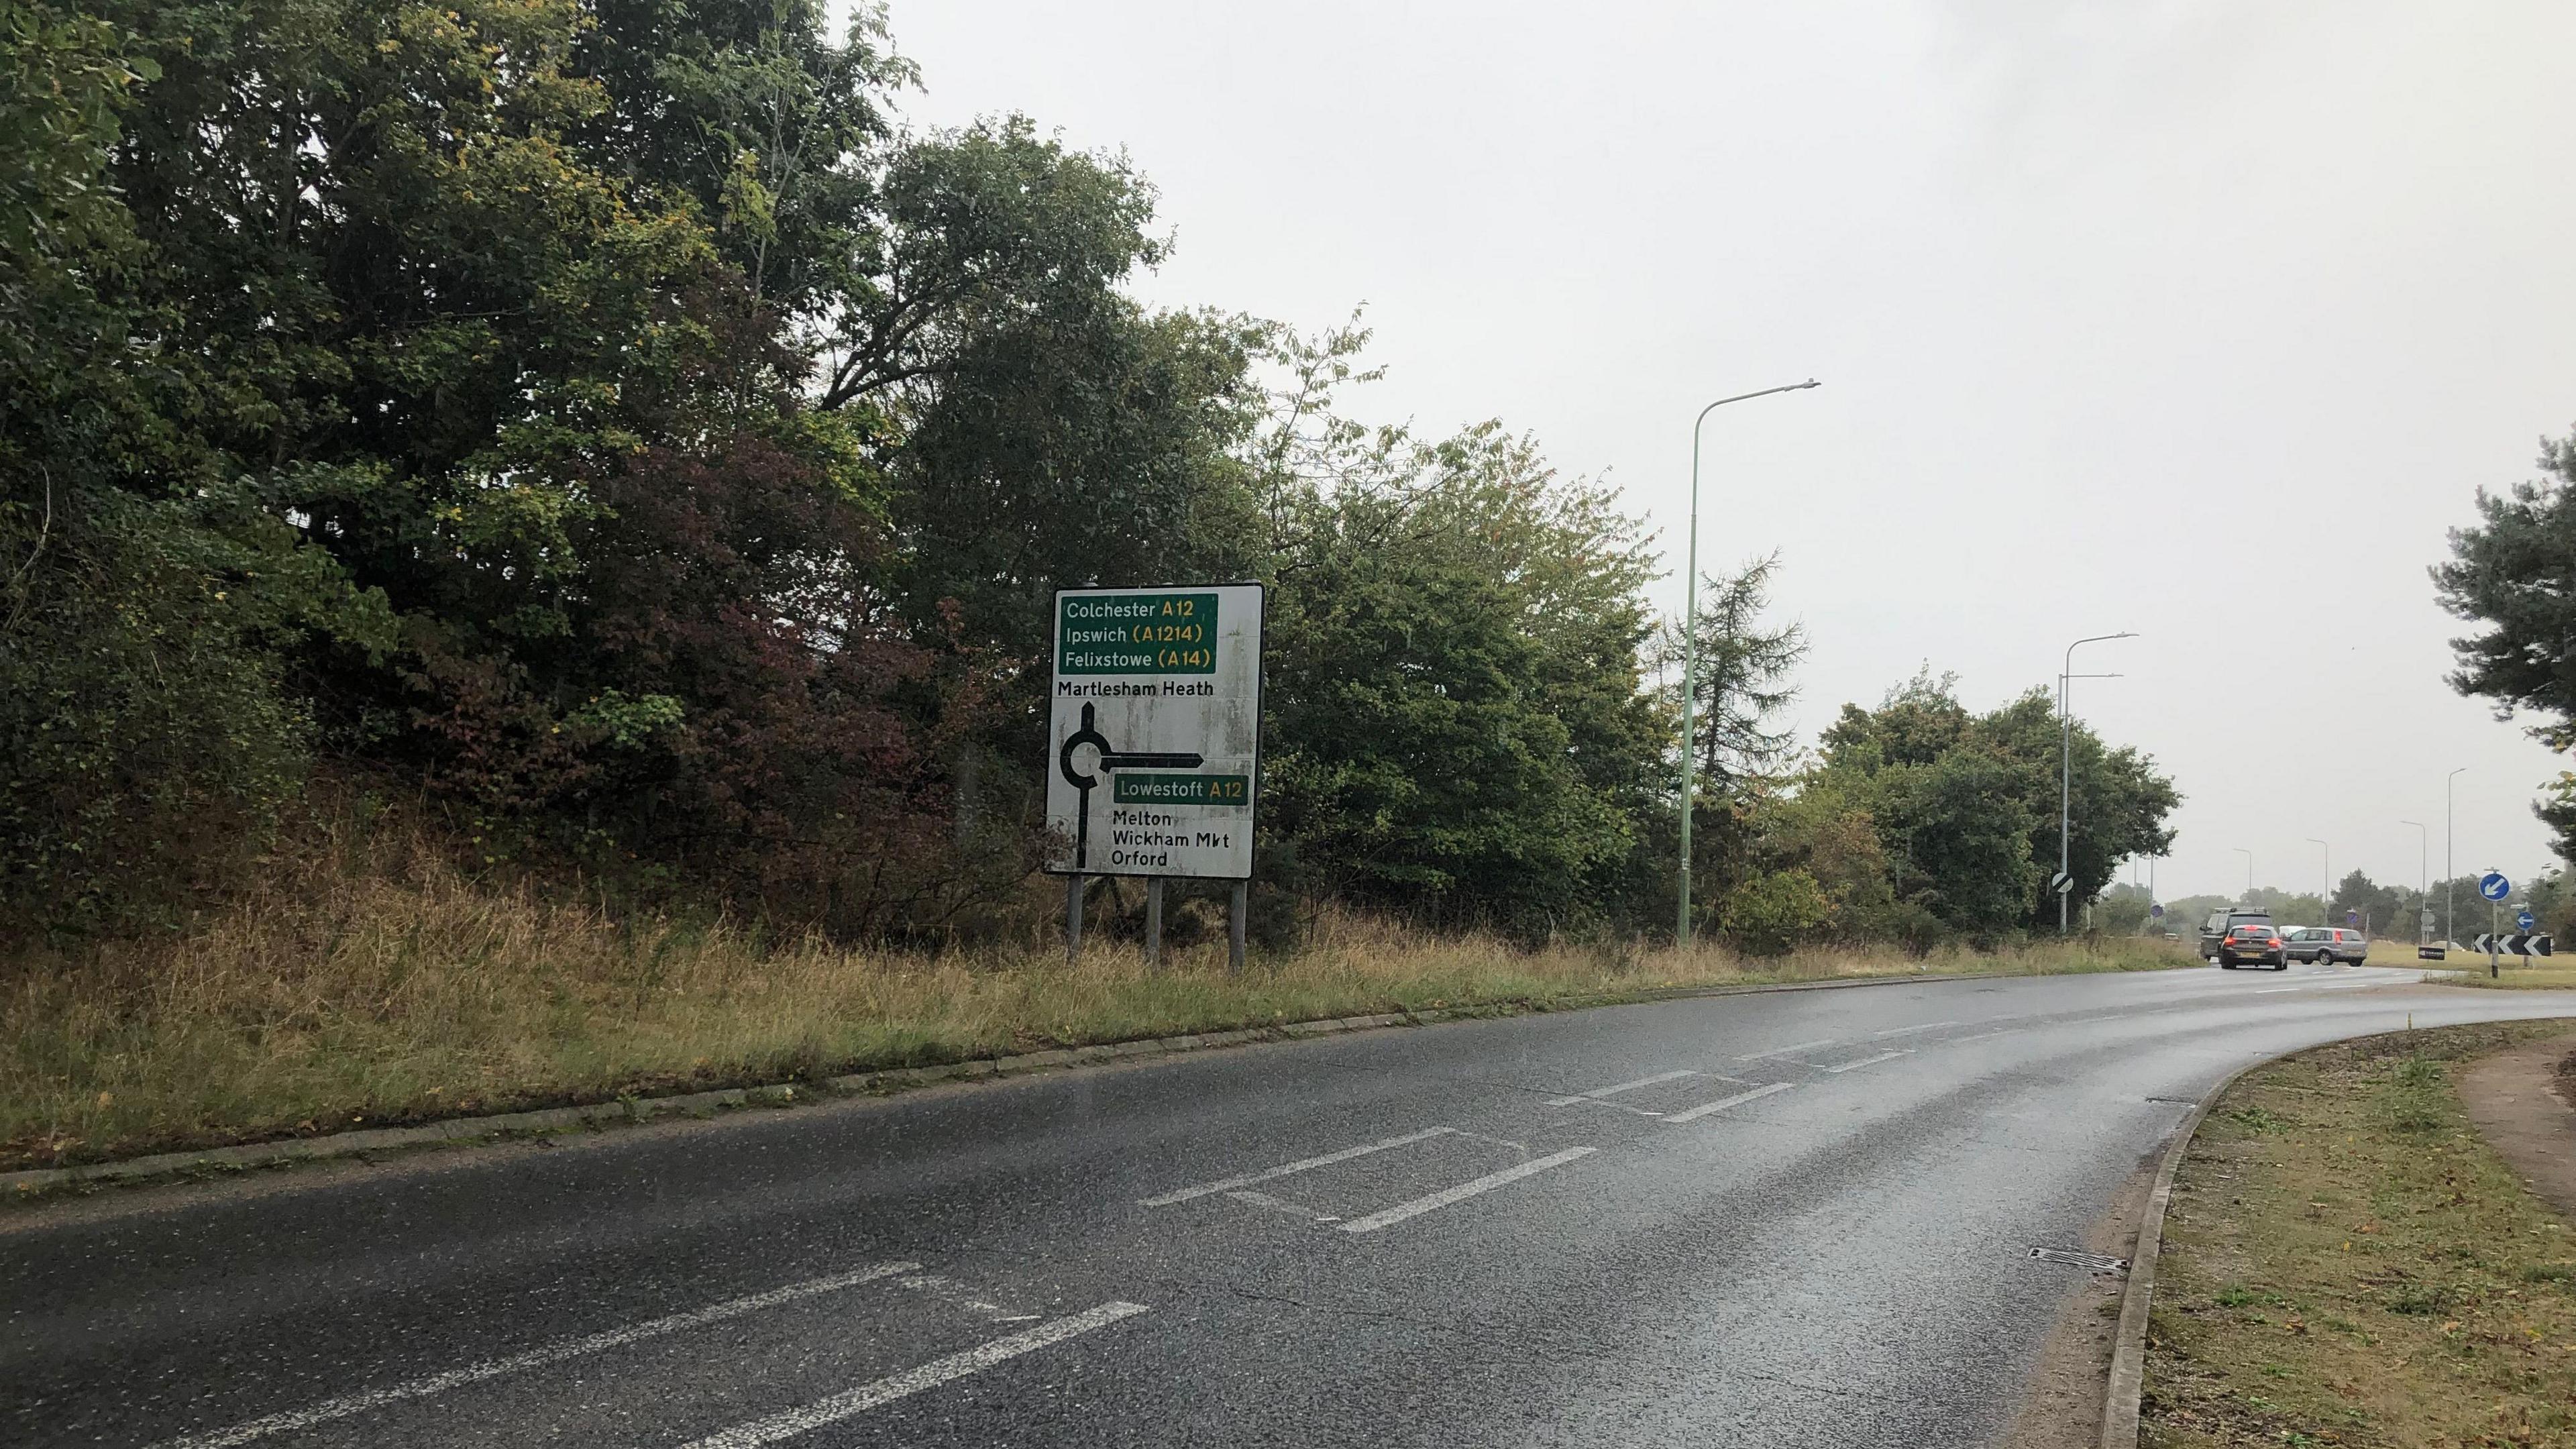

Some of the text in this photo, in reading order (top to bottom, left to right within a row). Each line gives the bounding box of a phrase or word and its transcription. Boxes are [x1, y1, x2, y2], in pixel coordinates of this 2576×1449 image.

[1067, 600, 1193, 618] Colchester A12
[1067, 623, 1202, 645] Ipswich (A1214)
[1065, 649, 1210, 667] Felixstowe (A14)
[1058, 681, 1214, 696] Martlesham Heath
[1121, 780, 1242, 798] Lowestoft A12
[1113, 810, 1171, 826] Melton
[1113, 830, 1189, 847] Wickham
[1112, 850, 1167, 866] Orford
